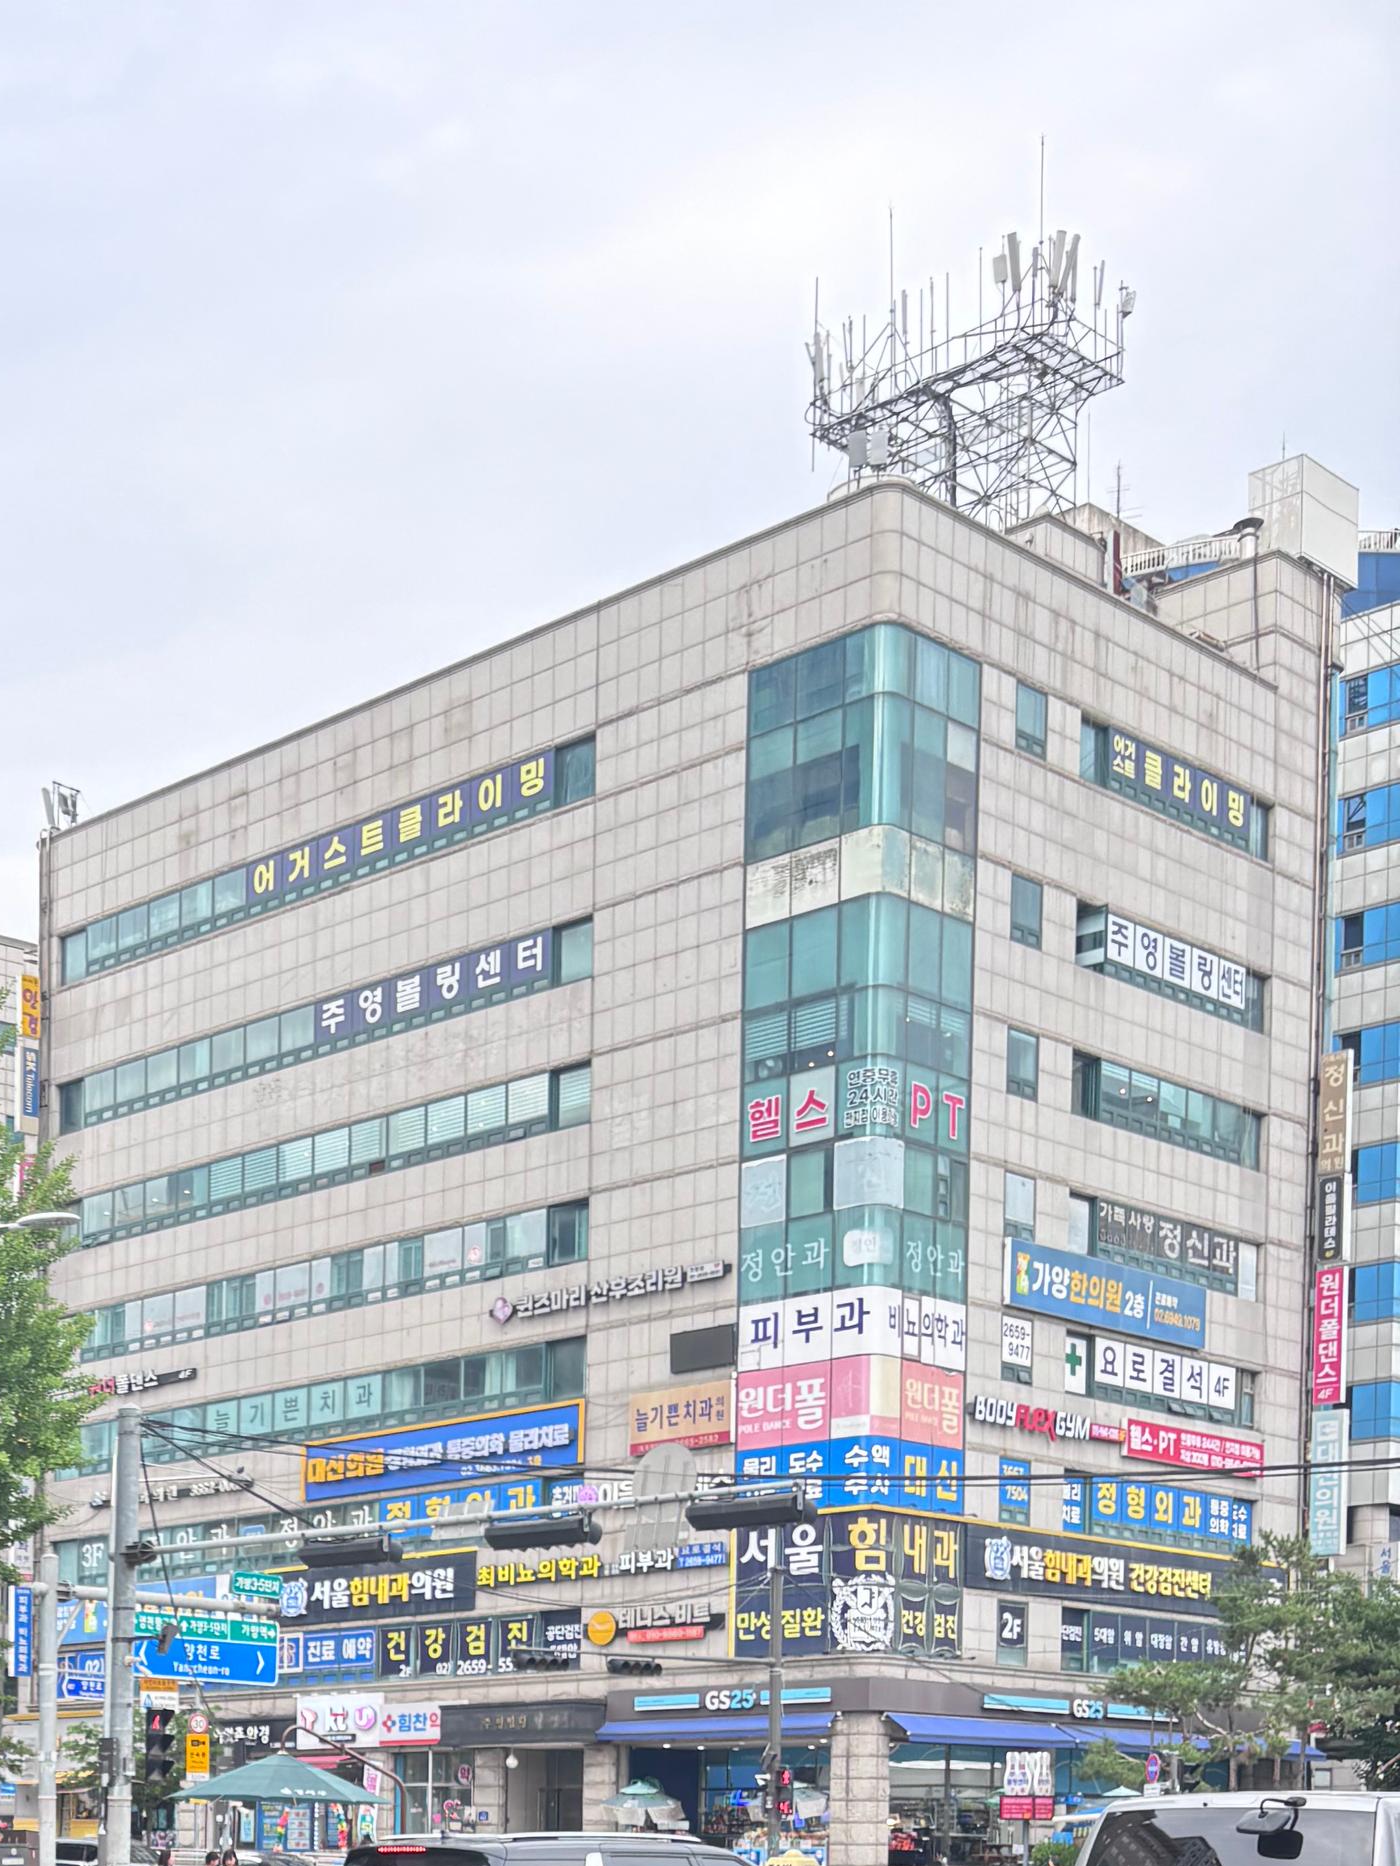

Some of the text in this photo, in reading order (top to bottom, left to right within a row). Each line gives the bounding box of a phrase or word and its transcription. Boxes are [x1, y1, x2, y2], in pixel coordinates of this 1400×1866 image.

[1145, 751, 1245, 827] 클라이밍
[253, 757, 546, 894] 어거스트클라이밍
[321, 936, 544, 1034] 주영볼링센터
[1111, 920, 1244, 1004] 주영볼링센터
[749, 1089, 829, 1142] 헬스
[910, 1081, 965, 1139] PT
[1323, 1066, 1345, 1156] 정신과
[740, 1237, 831, 1283] 정안과
[1159, 1220, 1239, 1276] 정신과
[590, 1266, 683, 1305] 산후조리원
[1032, 1260, 1124, 1314] 가양한의원
[751, 1297, 871, 1349] 피부과
[888, 1304, 966, 1352] 비뇨의학과
[1100, 1346, 1204, 1399] 요로결석
[738, 1377, 826, 1431] 원더폴
[904, 1378, 960, 1436] 원더폴
[789, 1450, 824, 1473] 도수
[844, 1444, 890, 1468] 수액
[904, 1455, 958, 1502] 대신
[1097, 1483, 1202, 1529] 정형외과
[477, 1554, 602, 1588] 최비뇨의학과
[619, 1546, 676, 1575] 피부과
[1011, 1544, 1212, 1600] 서울힘내과의원 건강검진센터
[311, 1567, 454, 1609] 서울힘내과의원
[386, 1620, 528, 1662] 건강검진
[1001, 1611, 1022, 1640] 2F
[705, 1690, 756, 1710] GS25
[1073, 1699, 1104, 1719] GS25
